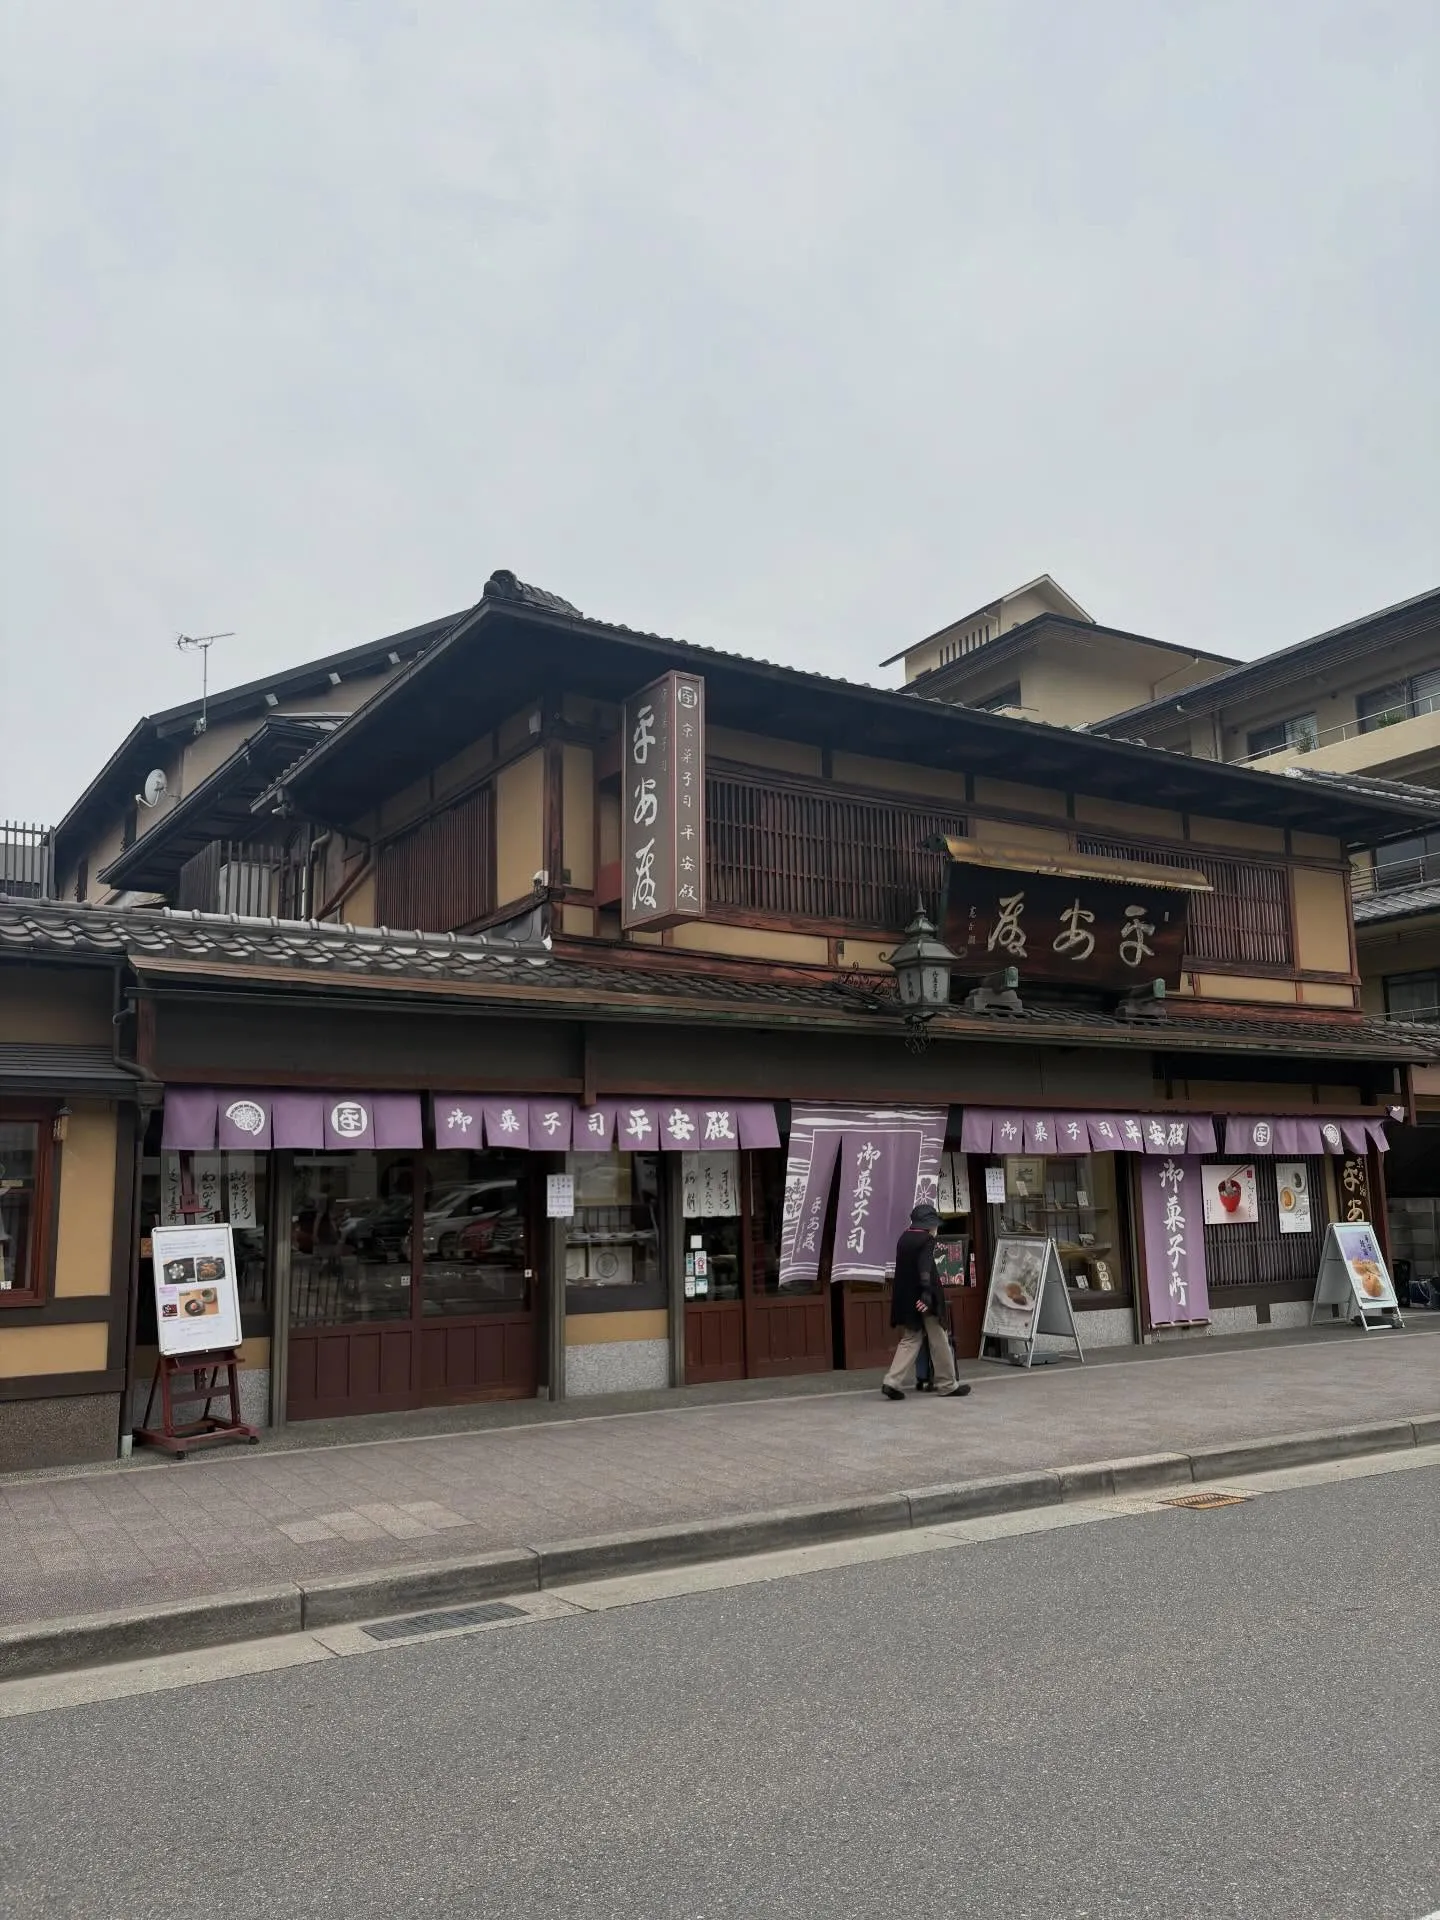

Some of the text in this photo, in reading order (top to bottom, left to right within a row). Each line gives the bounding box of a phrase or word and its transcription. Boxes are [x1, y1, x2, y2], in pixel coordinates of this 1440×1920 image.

[632, 705, 658, 910] 平安殿
[987, 891, 1155, 968] 平安殿
[846, 1142, 881, 1254] 御菓子司
